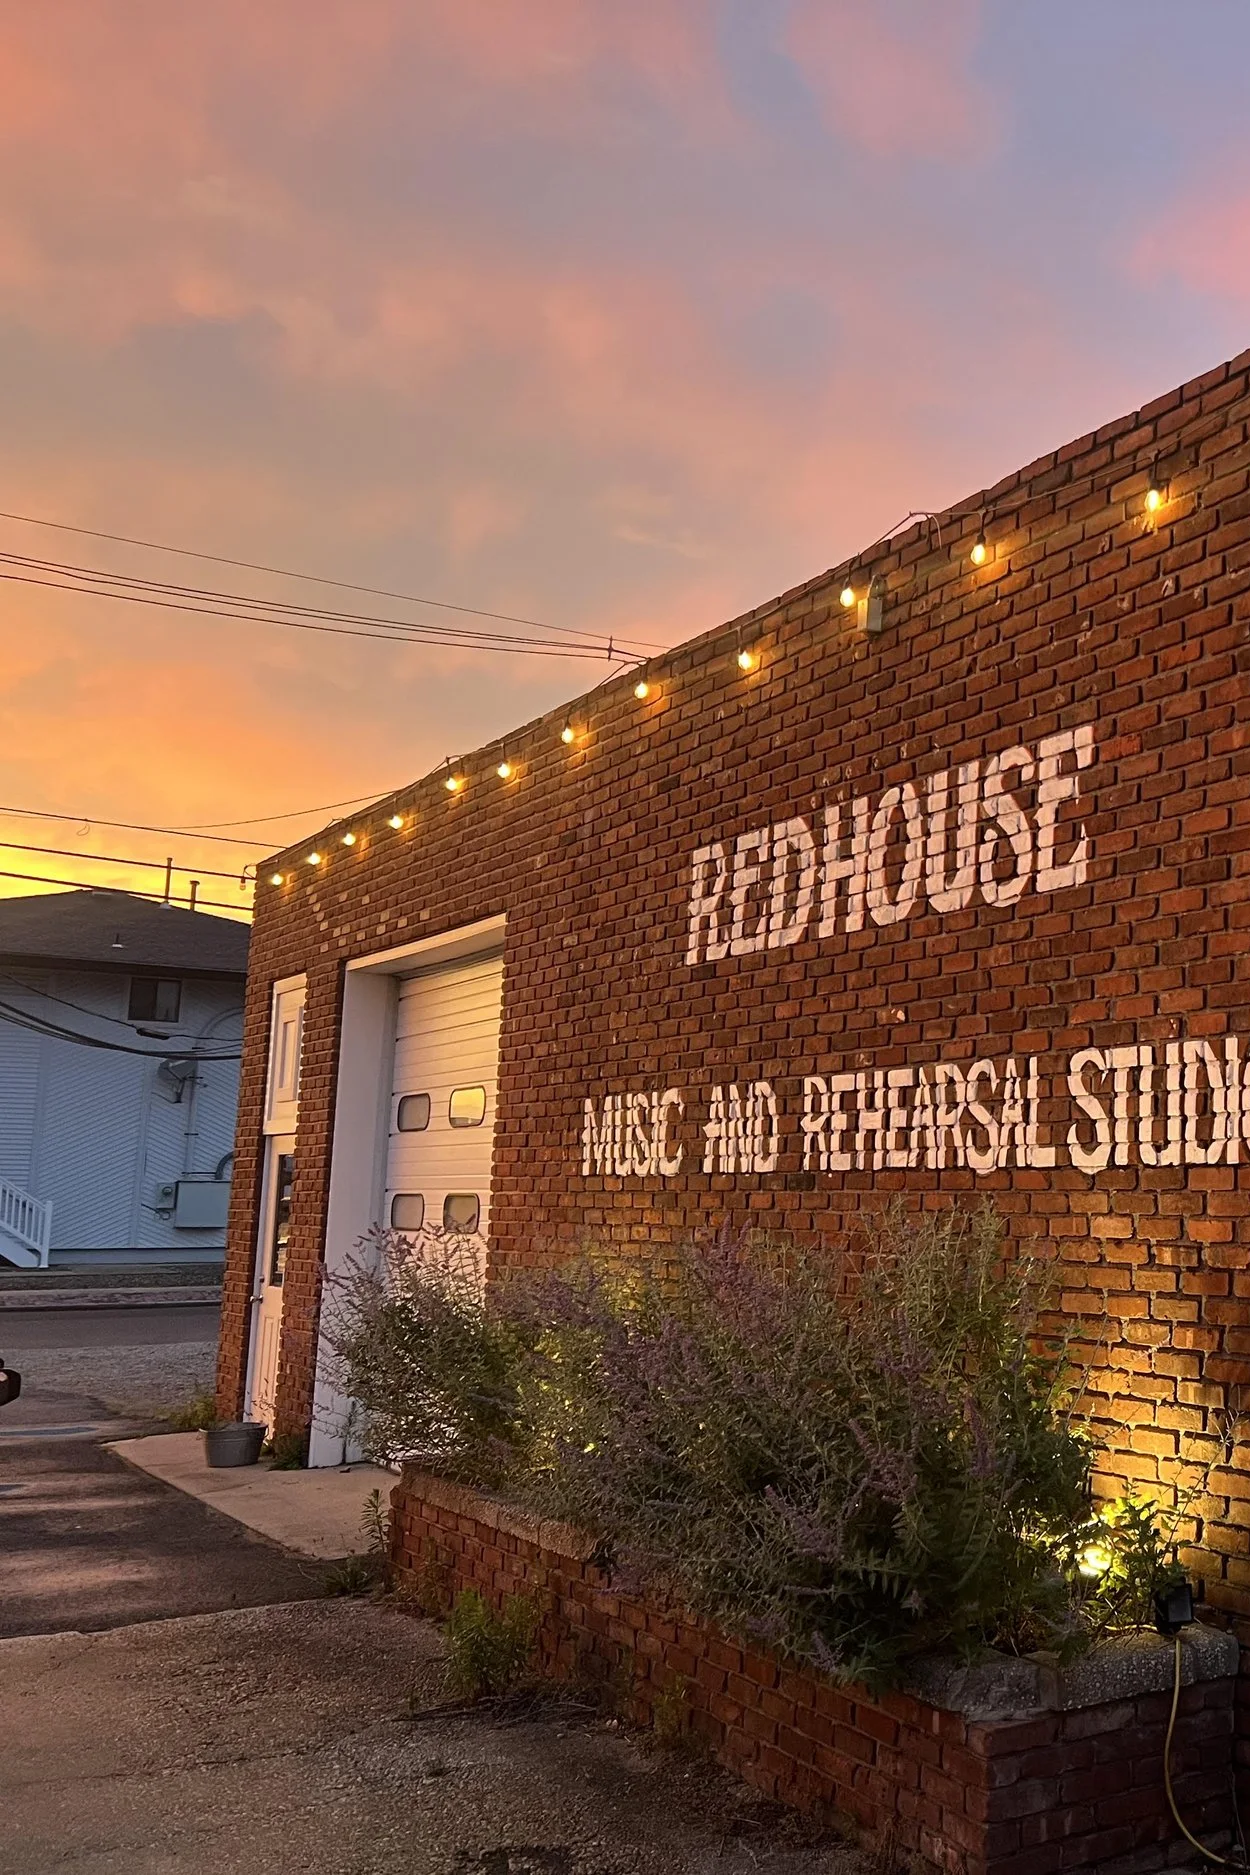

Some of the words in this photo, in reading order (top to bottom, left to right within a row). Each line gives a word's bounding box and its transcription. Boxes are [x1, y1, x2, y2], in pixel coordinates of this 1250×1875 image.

[581, 1088, 684, 1177] MUSIC
[703, 1081, 779, 1174] AND
[801, 1057, 1056, 1175] REHEARSAL
